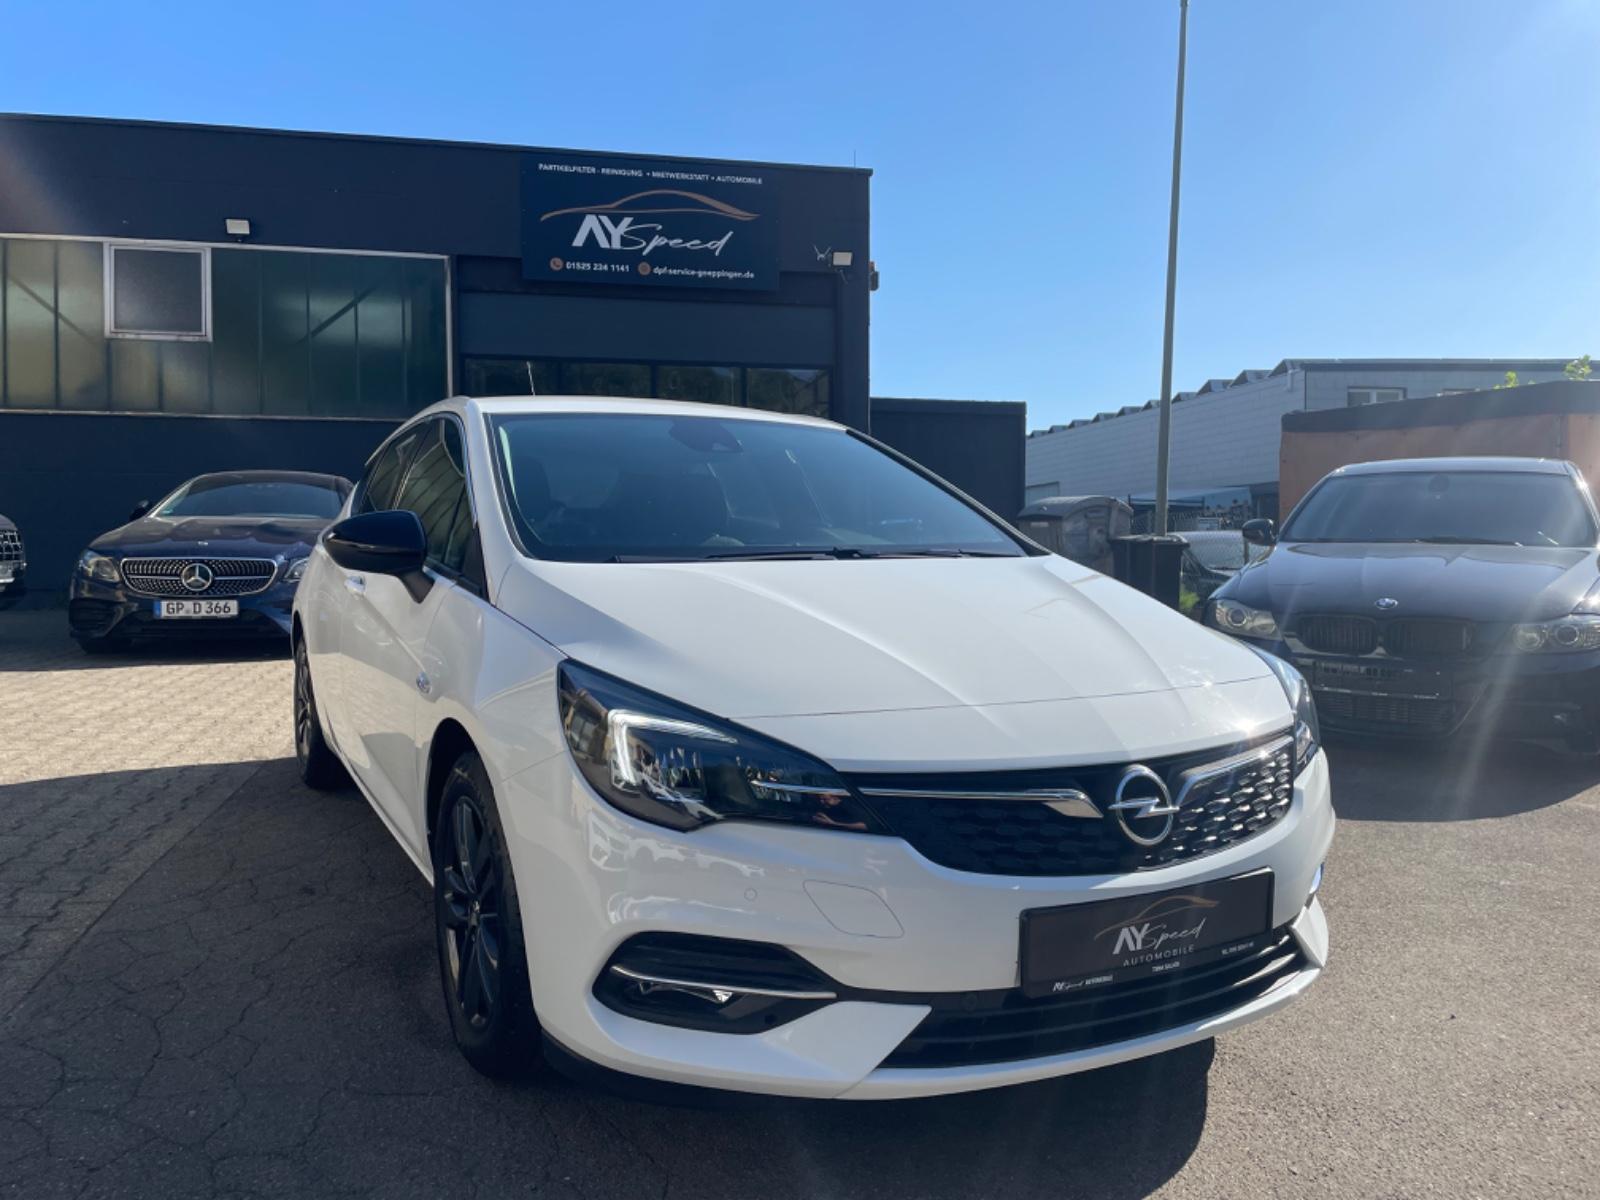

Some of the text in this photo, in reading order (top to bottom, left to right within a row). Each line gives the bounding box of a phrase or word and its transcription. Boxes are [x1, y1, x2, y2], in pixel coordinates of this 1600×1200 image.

[538, 163, 763, 185] PARTIKELFILTER REINIGUNG MIETWERKSTATT AUTOMOBILE
[566, 261, 630, 273] 01525 224 1141
[166, 601, 231, 614] GP D 366
[1122, 944, 1195, 967] AUTOMOBILE
